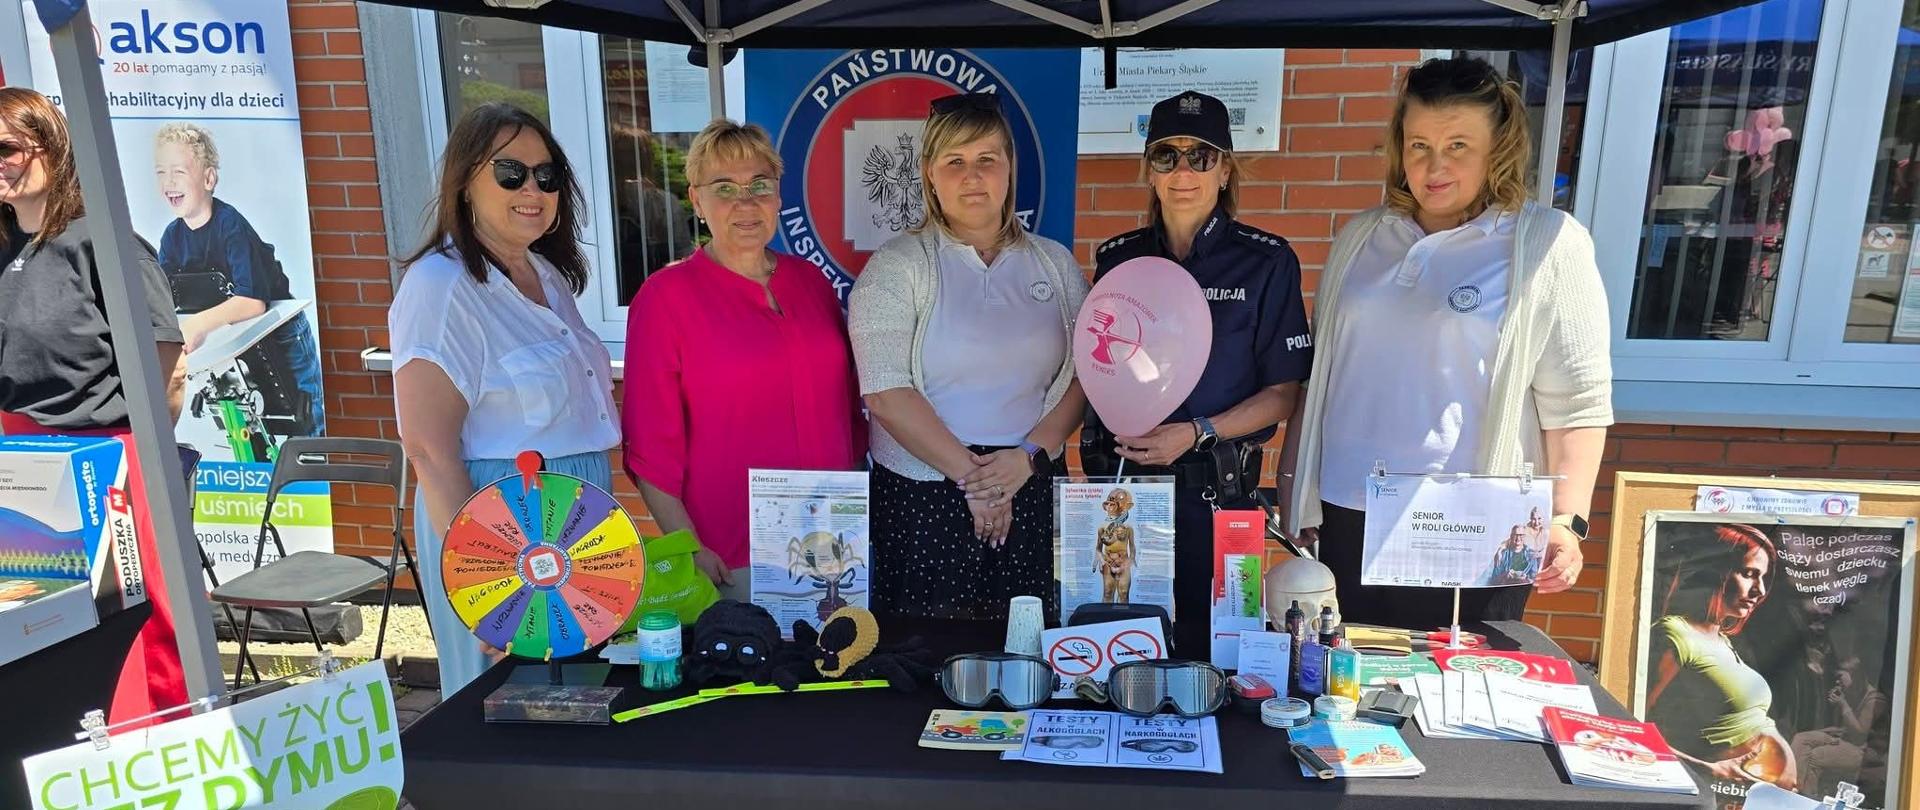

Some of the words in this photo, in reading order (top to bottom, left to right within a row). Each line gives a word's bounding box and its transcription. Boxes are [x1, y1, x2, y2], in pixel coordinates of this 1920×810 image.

[110, 9, 265, 54] akson
[113, 62, 130, 73] 20
[133, 62, 149, 73] lat
[152, 63, 216, 75] pomagamy
[221, 65, 228, 73] z
[231, 63, 267, 75] pasją!
[1147, 66, 1176, 77] Piekary
[1179, 64, 1207, 76] Śląskie
[811, 48, 998, 110] PAŃSTWOWA
[107, 91, 206, 109] habilitacyjny
[211, 92, 234, 107] dla
[238, 93, 284, 108] dzieci
[780, 206, 851, 300] INSPEK
[113, 493, 124, 507] M
[1412, 511, 1444, 520] SENIOR
[1411, 523, 1421, 531] W
[1421, 523, 1441, 532] ROLI
[1442, 522, 1486, 534] GŁÓWNEJ
[196, 531, 249, 546] opolska
[570, 534, 606, 557] NAGRODA
[1782, 532, 1824, 548] Paląc
[1829, 533, 1893, 547] podczas
[114, 518, 135, 597] PODUSZKA
[125, 524, 142, 595] ORTOPEDYCZNA
[1777, 549, 1812, 567] ciąży
[1815, 545, 1901, 563] dostarczasz
[1785, 566, 1830, 580] swemu
[1837, 555, 1887, 573] dziecku
[467, 577, 513, 607] NAGRODA
[1795, 582, 1831, 593] tlenek
[1833, 572, 1868, 588] węgla
[1813, 591, 1846, 606] (czad)
[1046, 715, 1098, 724] TESTY
[1133, 718, 1187, 727] TESTY
[41, 718, 268, 810] CHCEMY
[278, 681, 365, 748] ŻYĆ
